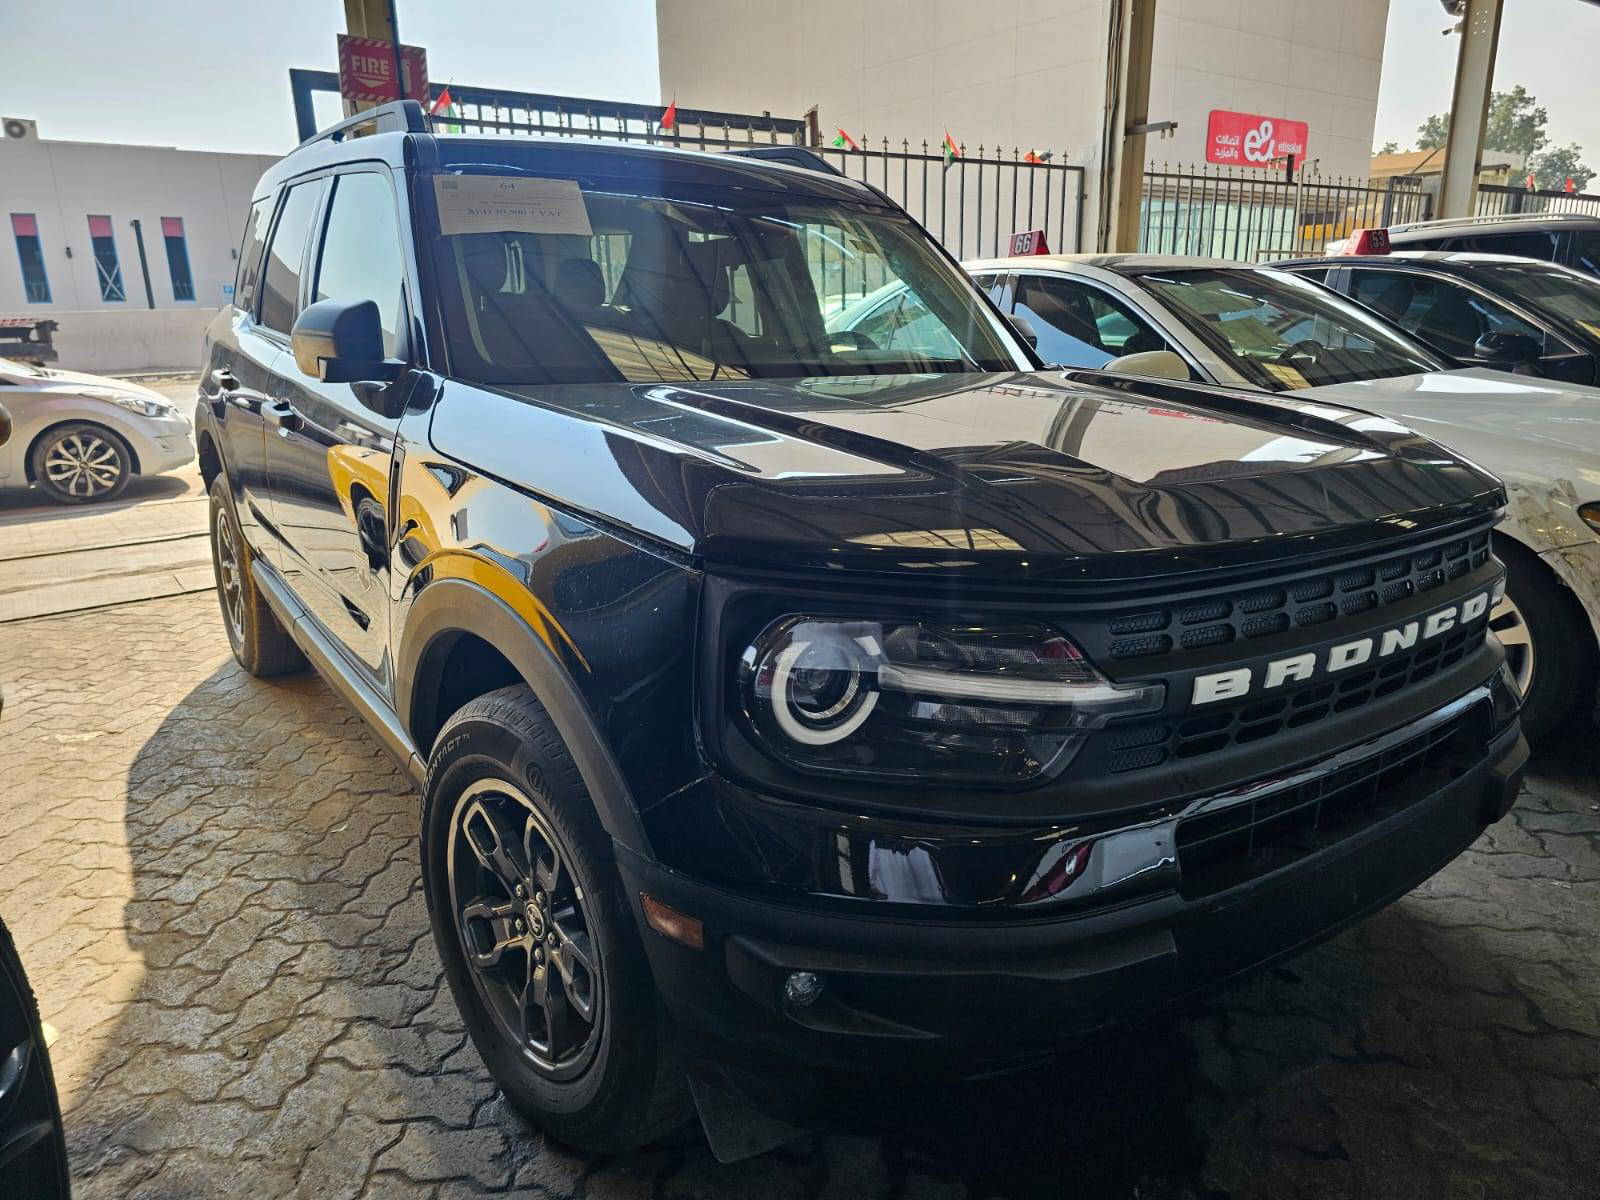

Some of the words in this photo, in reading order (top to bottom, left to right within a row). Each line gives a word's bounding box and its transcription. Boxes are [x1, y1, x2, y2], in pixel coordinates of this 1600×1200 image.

[351, 55, 390, 75] FIRE
[1214, 146, 1239, 159] والمزيد
[1278, 141, 1302, 153] etisalat
[467, 208, 491, 216] AED
[538, 208, 561, 218] VAT
[1015, 233, 1032, 254] 66
[1372, 230, 1385, 248] 53
[1191, 590, 1489, 706] BRONCO
